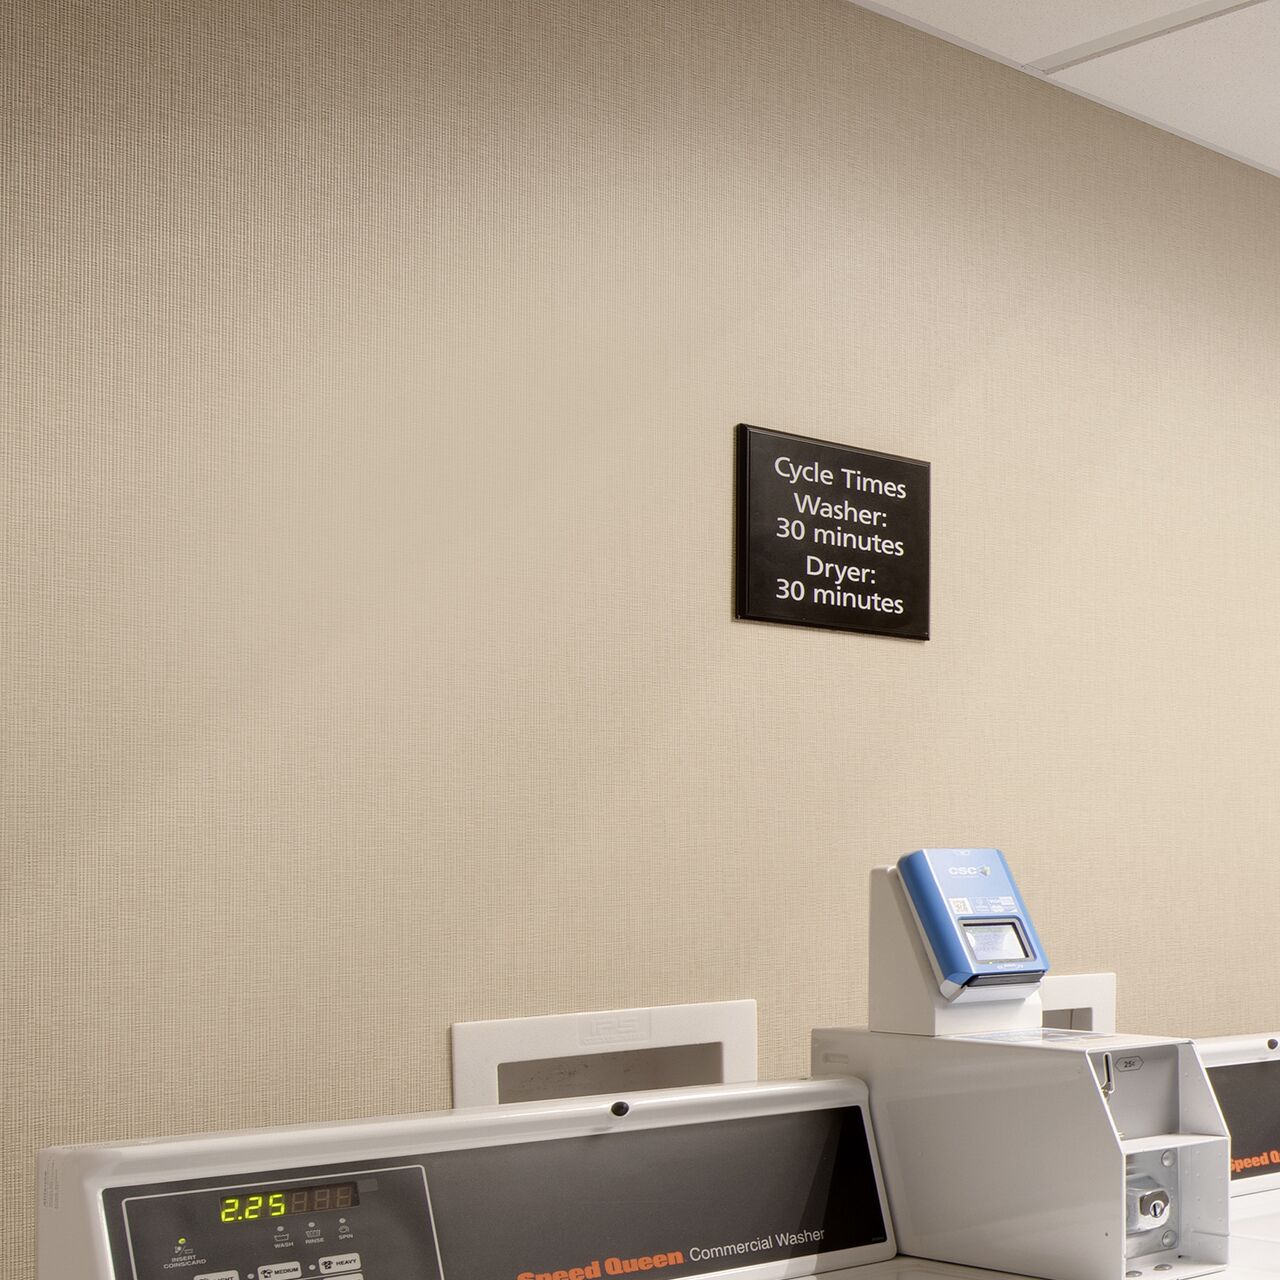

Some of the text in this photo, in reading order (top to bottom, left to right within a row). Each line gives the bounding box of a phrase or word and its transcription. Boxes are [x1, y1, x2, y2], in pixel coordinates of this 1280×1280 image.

[774, 457, 907, 499] Cycle Times
[794, 492, 887, 527] Washer:
[776, 517, 904, 556] 30 minutes
[806, 555, 876, 585] Dryer:
[775, 578, 904, 614] 30 minutes
[221, 1193, 285, 1222] 2.25
[171, 1254, 197, 1263] INSERT
[274, 1241, 294, 1249] WASH
[604, 1249, 685, 1277] Queen
[689, 1235, 773, 1262] Commercial
[774, 1227, 826, 1247] Washer
[274, 1267, 299, 1276] MEDIUM
[335, 1258, 357, 1266] HEAVY
